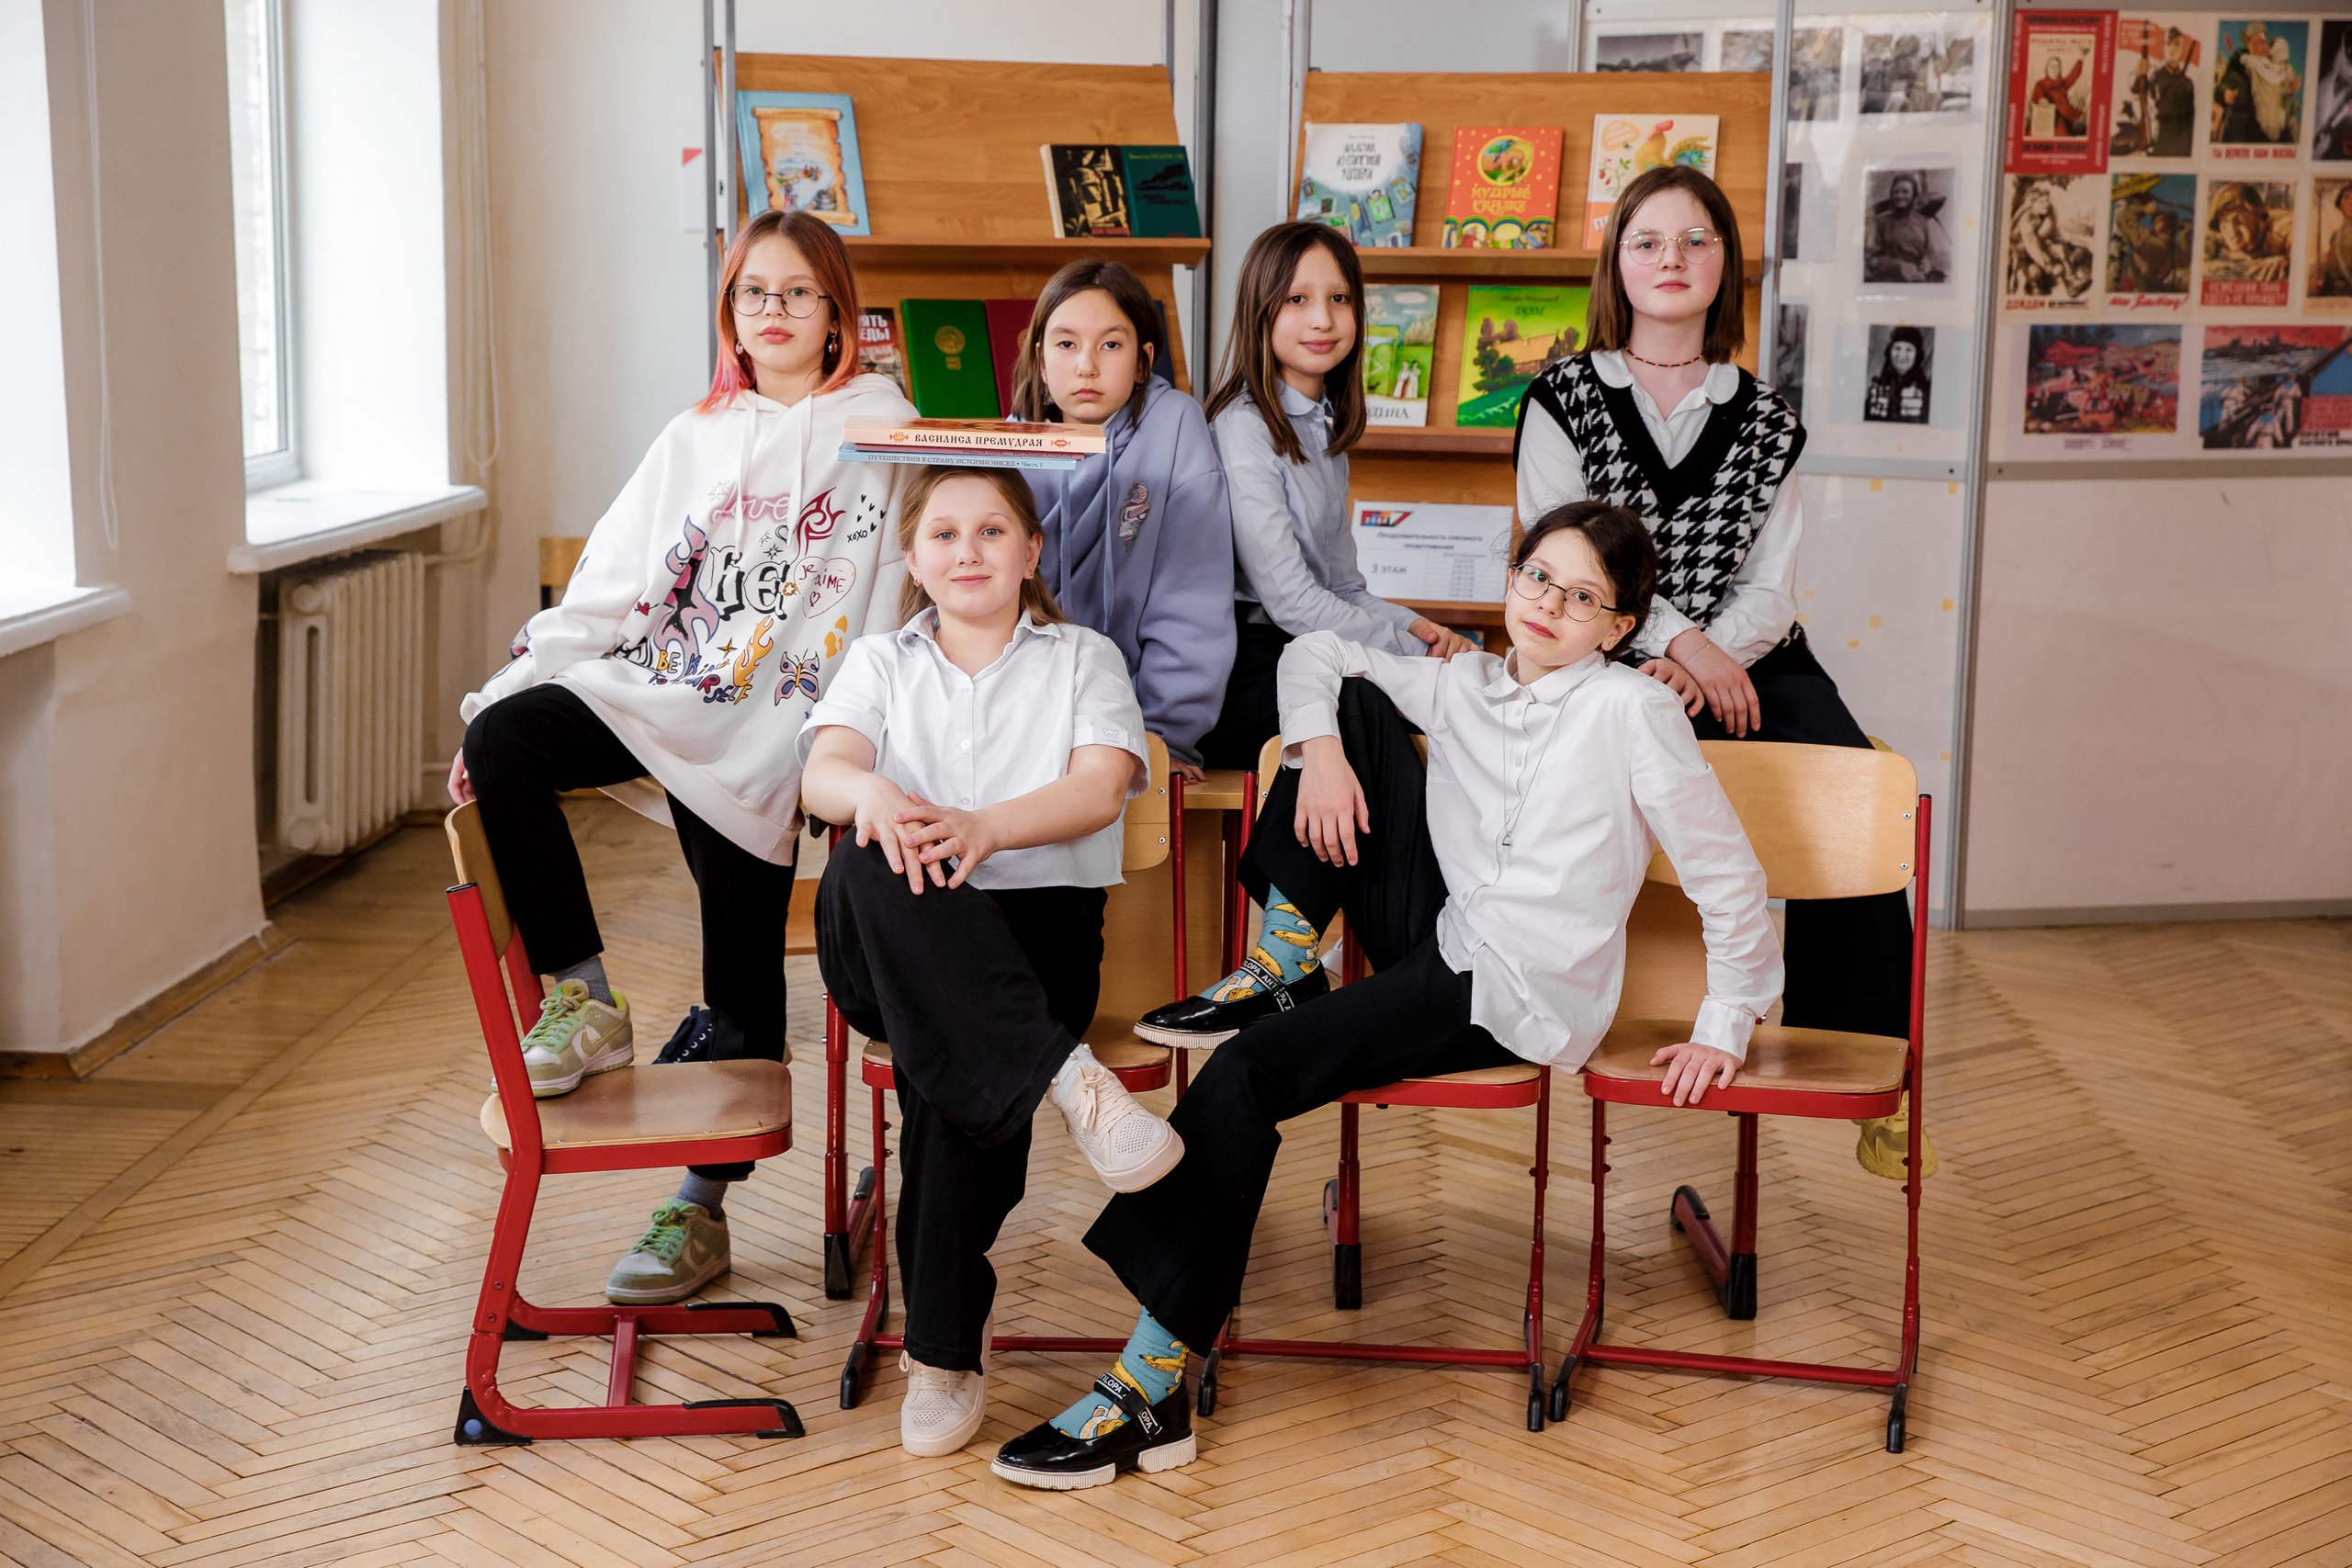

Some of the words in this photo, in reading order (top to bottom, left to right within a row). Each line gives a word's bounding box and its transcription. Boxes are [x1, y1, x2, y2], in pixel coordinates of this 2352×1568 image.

[858, 314, 888, 328] ЯТЬ
[859, 327, 890, 343] ЕДЫ
[915, 434, 972, 445] ВАСИЛИСА
[975, 436, 1043, 448] ПРЕМУДРАЯ
[868, 454, 921, 462] ПУТЕШЕСТВИЯ
[927, 457, 955, 465] СТРАНУ
[1372, 563, 1378, 573] 3
[1381, 566, 1408, 574] ЭТАЖ
[704, 684, 752, 705] SELF
[1141, 1410, 1153, 1429] OPA
